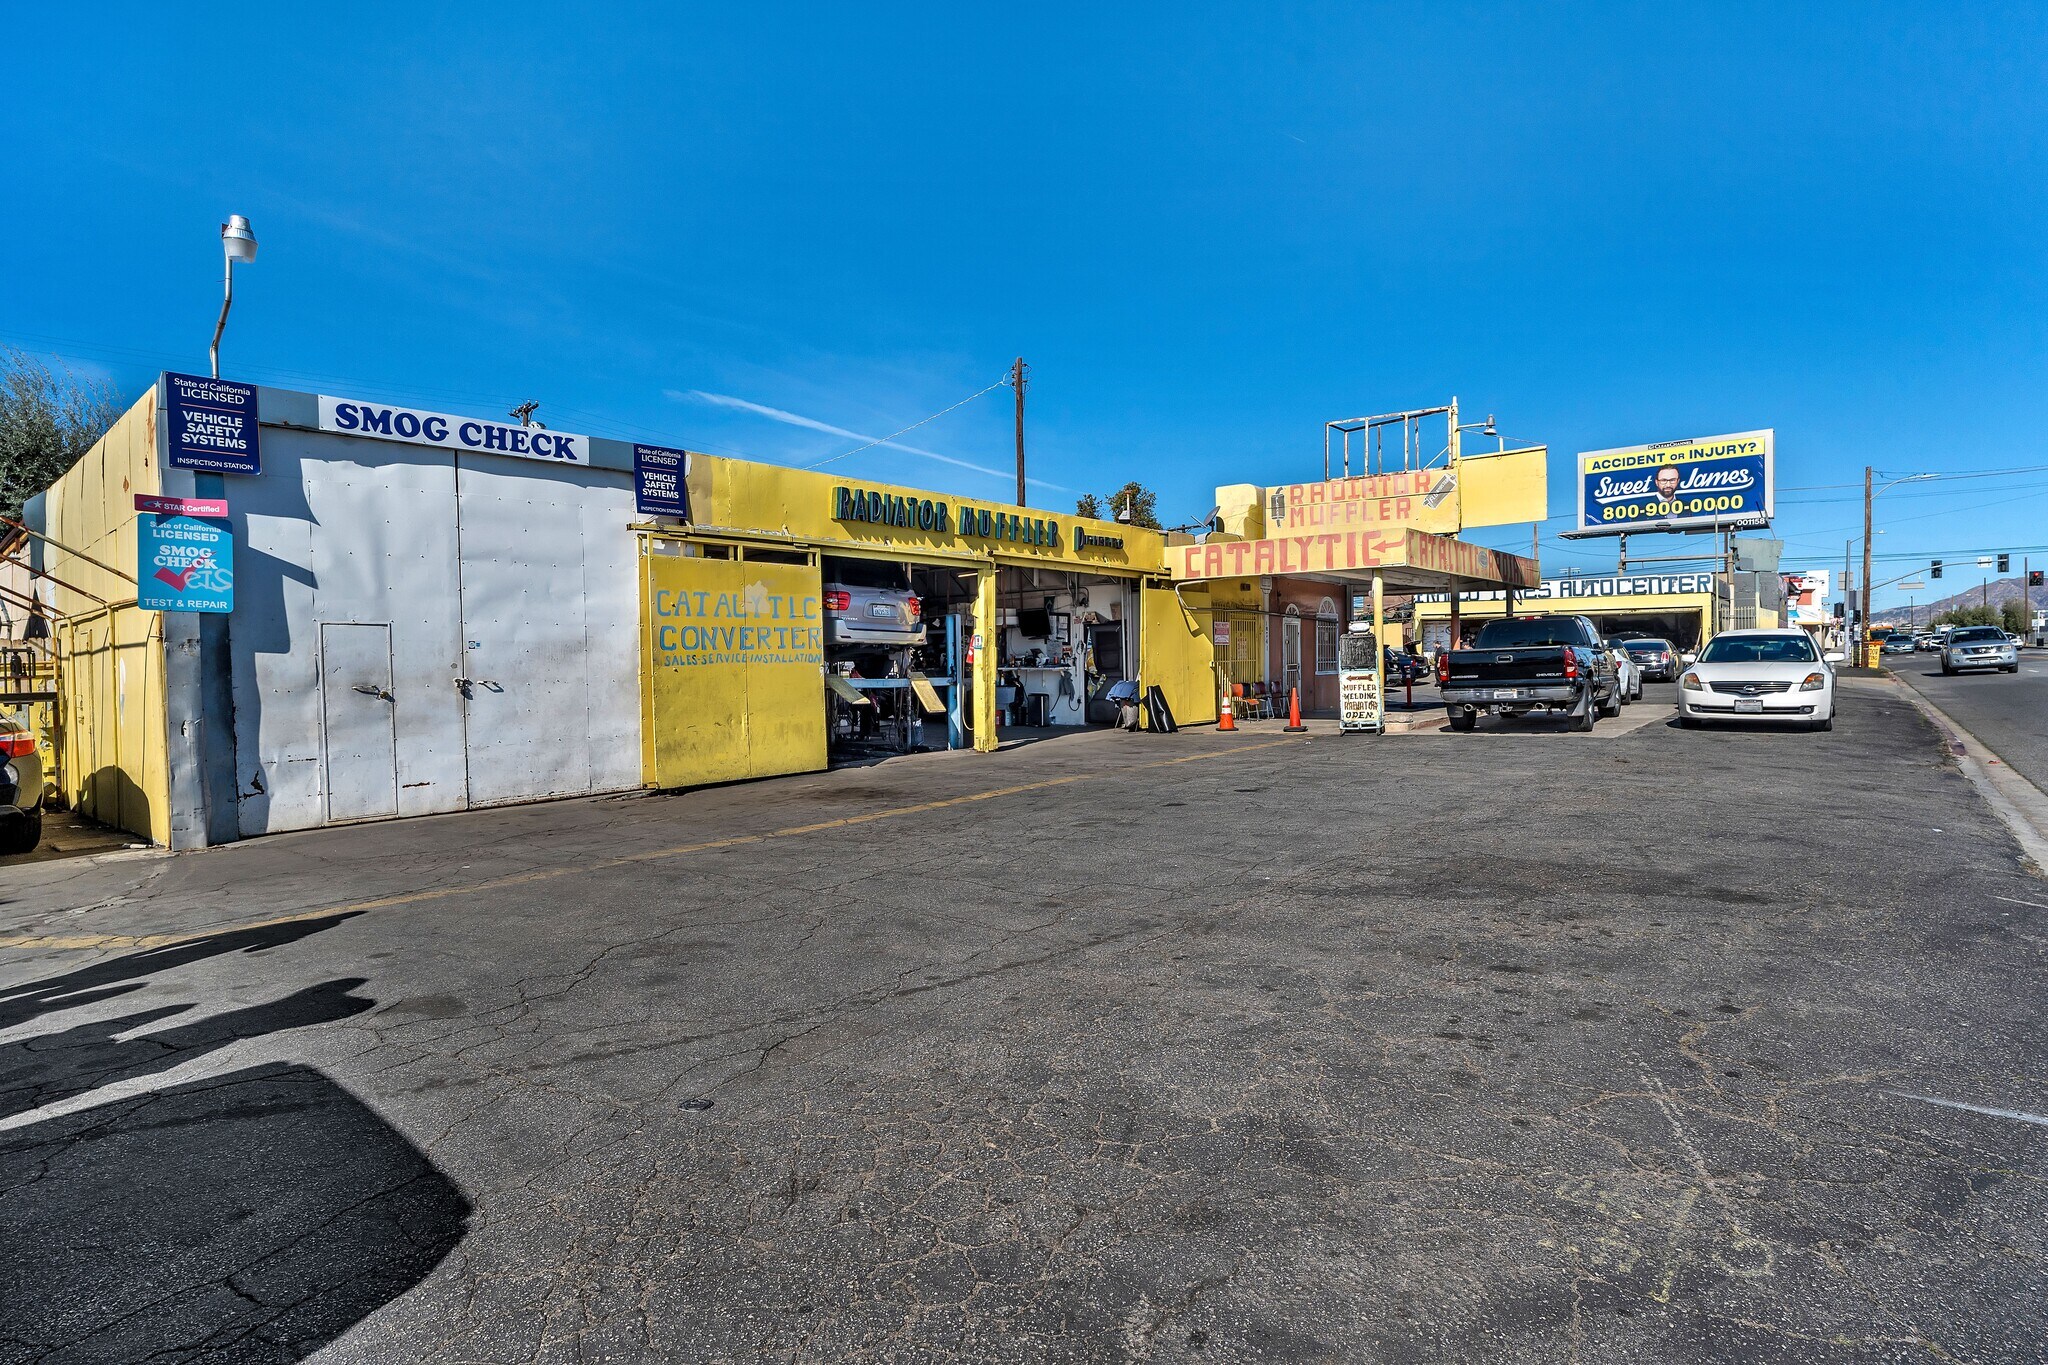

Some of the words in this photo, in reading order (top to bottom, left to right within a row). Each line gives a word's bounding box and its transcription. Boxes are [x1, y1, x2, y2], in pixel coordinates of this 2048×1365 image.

[174, 377, 198, 388] State
[199, 382, 209, 390] of
[209, 383, 251, 396] California
[181, 387, 245, 404] LICENSED
[182, 410, 243, 427] VEHICLE
[186, 422, 242, 438] SAFETY
[335, 402, 449, 442] SMOG
[459, 422, 578, 461] CHECK
[181, 432, 247, 449] SYSTEMS
[641, 454, 678, 466] LICENSED
[657, 450, 681, 459] California
[1591, 452, 1666, 471] ACCIDENT
[1689, 442, 1757, 460] INJURY?
[177, 457, 223, 468] INSPECTION
[223, 462, 254, 470] STATION
[642, 472, 677, 483] VEHICLE
[645, 480, 676, 491] SAFETY
[1594, 476, 1652, 498] Sweet
[1680, 467, 1754, 489] James
[642, 488, 679, 499] SYSTEMS
[1290, 472, 1431, 505] RADIATOR
[164, 503, 185, 511] STAR
[186, 505, 220, 513] Certified
[1290, 497, 1411, 528] MUFFLER
[1602, 494, 1744, 521] 800-900-0000
[836, 486, 948, 532] RADIATOR
[959, 505, 1059, 547] MUFFLER
[150, 520, 172, 529] Sate
[183, 524, 221, 532] California
[152, 529, 219, 542] LICENSED
[159, 544, 213, 558] SMOG
[1185, 530, 1381, 578] CATALYTIC
[153, 556, 218, 570] CHECK
[1560, 574, 1711, 598] AUTOCENTER
[144, 598, 173, 607] TEST
[176, 599, 184, 607] &
[187, 600, 228, 609] REPAIR
[656, 589, 817, 619] CATALYTIC
[659, 625, 822, 651] CONVERTER
[1343, 684, 1377, 692] MUFFLER
[1343, 692, 1377, 700] WELDING
[1344, 700, 1378, 711] RADIATOR
